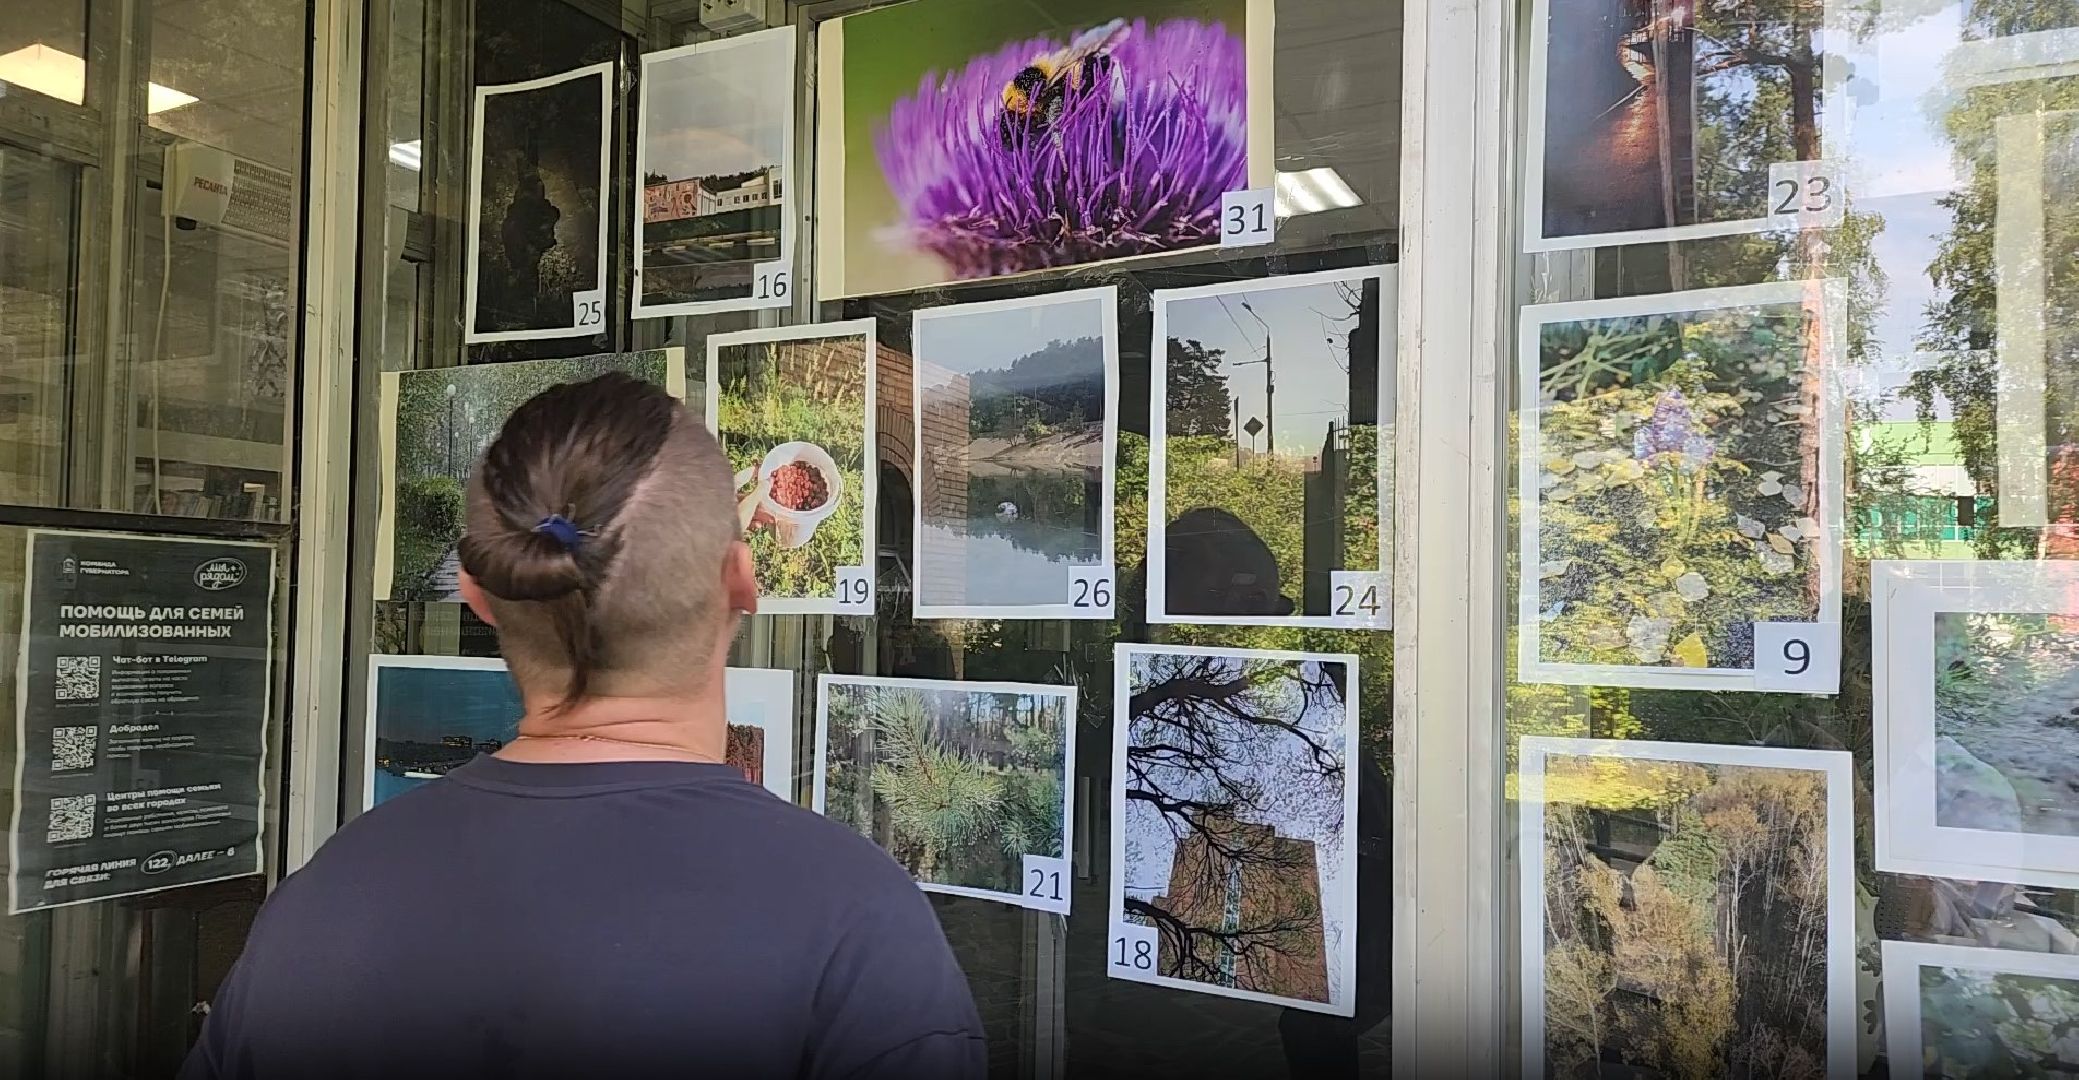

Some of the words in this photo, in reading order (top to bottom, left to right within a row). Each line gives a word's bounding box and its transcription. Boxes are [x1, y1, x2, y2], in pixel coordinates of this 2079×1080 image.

[1773, 176, 1831, 215] 23
[1227, 203, 1268, 235] 31
[757, 272, 787, 300] 16
[578, 300, 601, 326] 25
[838, 577, 869, 605] 19
[1072, 578, 1111, 609] 26
[1335, 585, 1381, 616] 24
[60, 605, 146, 621] ПОМОЩЬ
[149, 606, 184, 621] ДЛЯ
[188, 606, 244, 621] СЕМЕЙ
[59, 624, 232, 639] МОБИЛИЗОВАННЫХ
[112, 655, 153, 664] Чат-бот
[162, 656, 208, 665] Telegram
[1783, 638, 1811, 675] 9
[109, 724, 160, 734] Добродел
[106, 791, 146, 802] Центры
[45, 864, 99, 877] ГОРЯЧАЯ
[100, 858, 137, 871] ЛИНИЯ
[176, 850, 217, 866] ДАЛЕЕ
[1029, 868, 1063, 901] 21
[1114, 937, 1152, 970] 18
